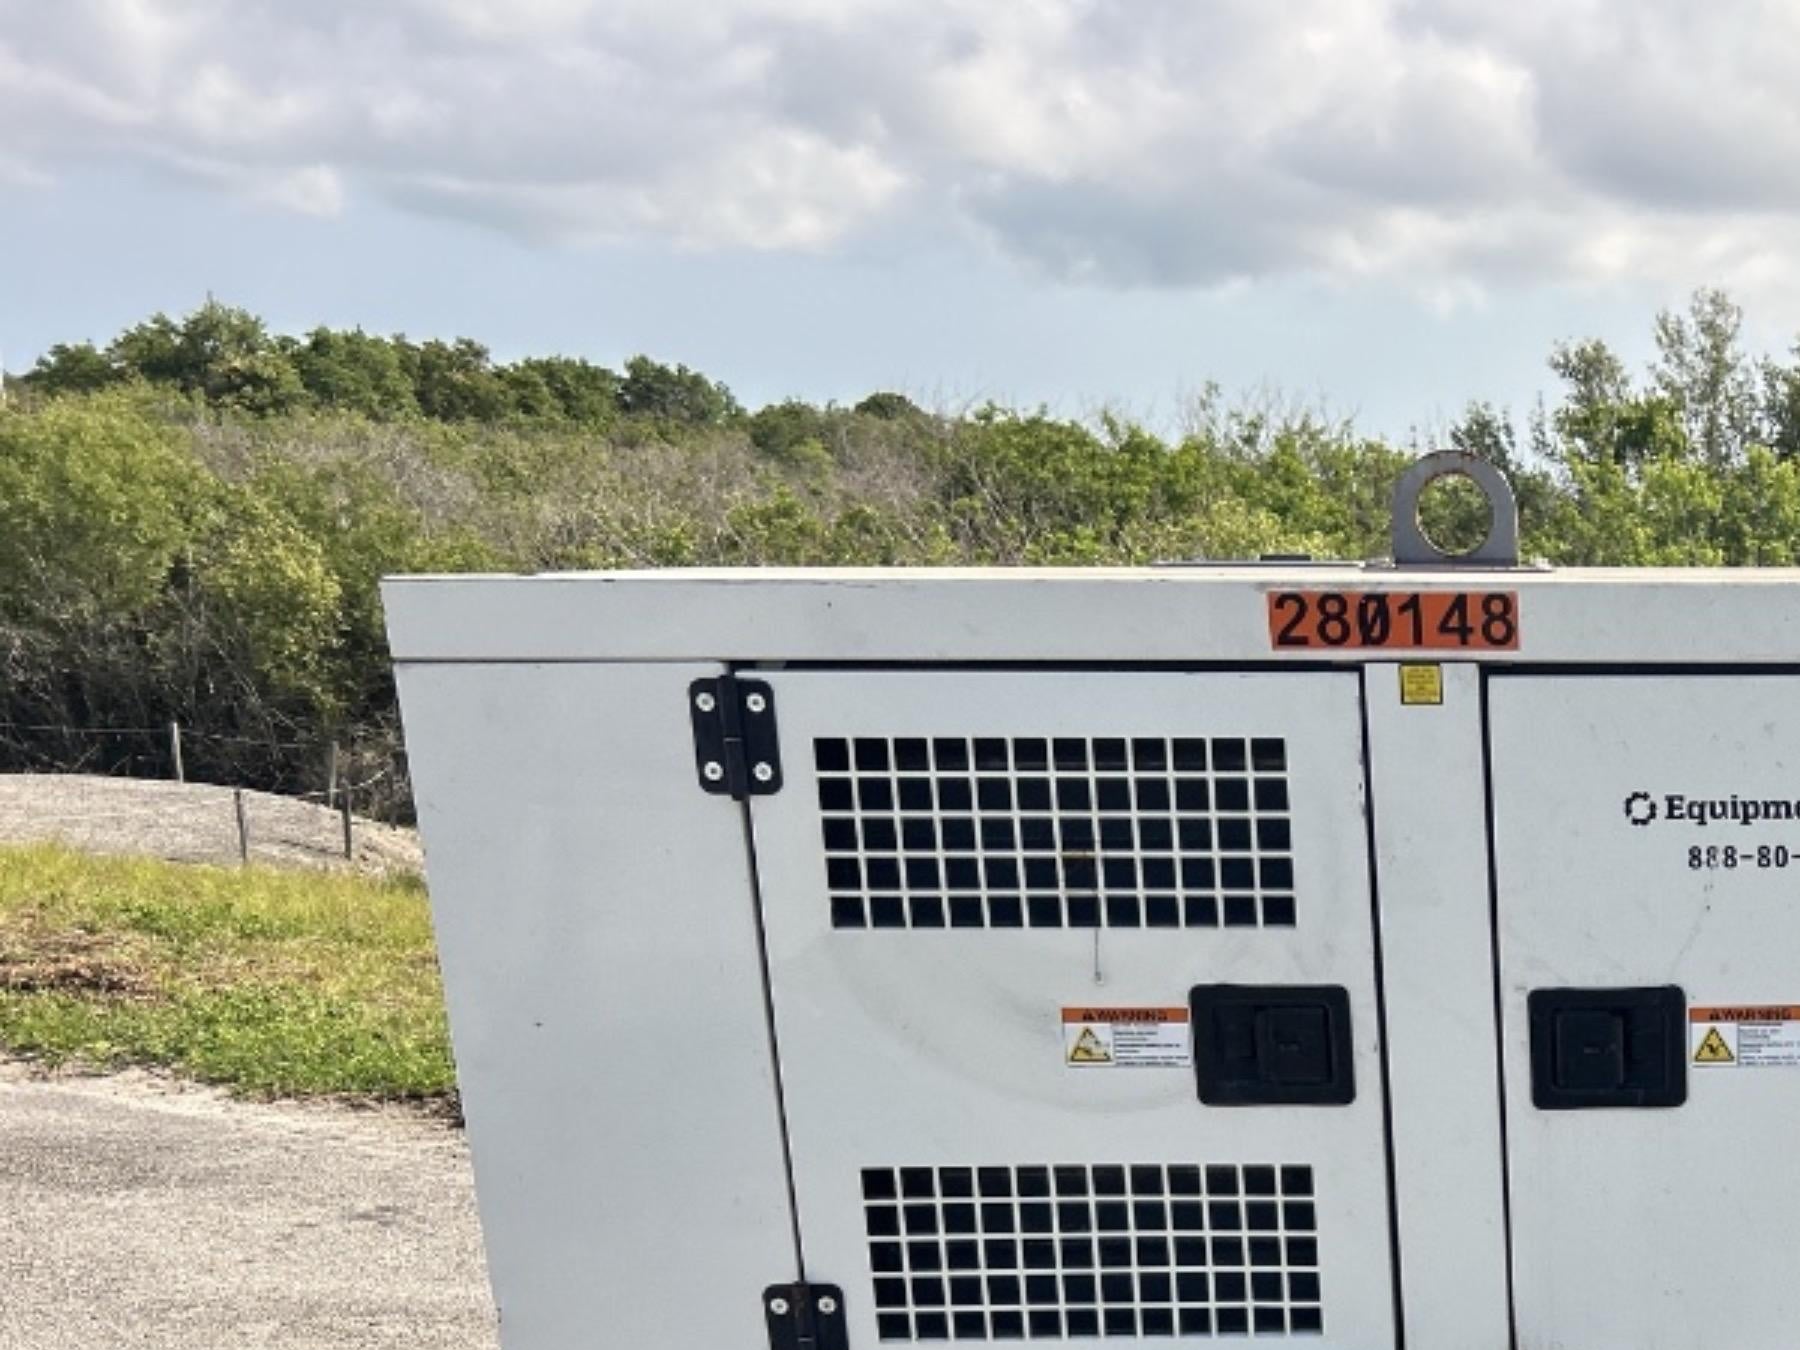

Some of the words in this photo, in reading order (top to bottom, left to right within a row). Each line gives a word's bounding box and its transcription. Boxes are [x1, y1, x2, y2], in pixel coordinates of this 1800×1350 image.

[1274, 593, 1515, 646] 280148
[1098, 1009, 1168, 1021] WARNING
[1722, 1008, 1792, 1021] WARNING
